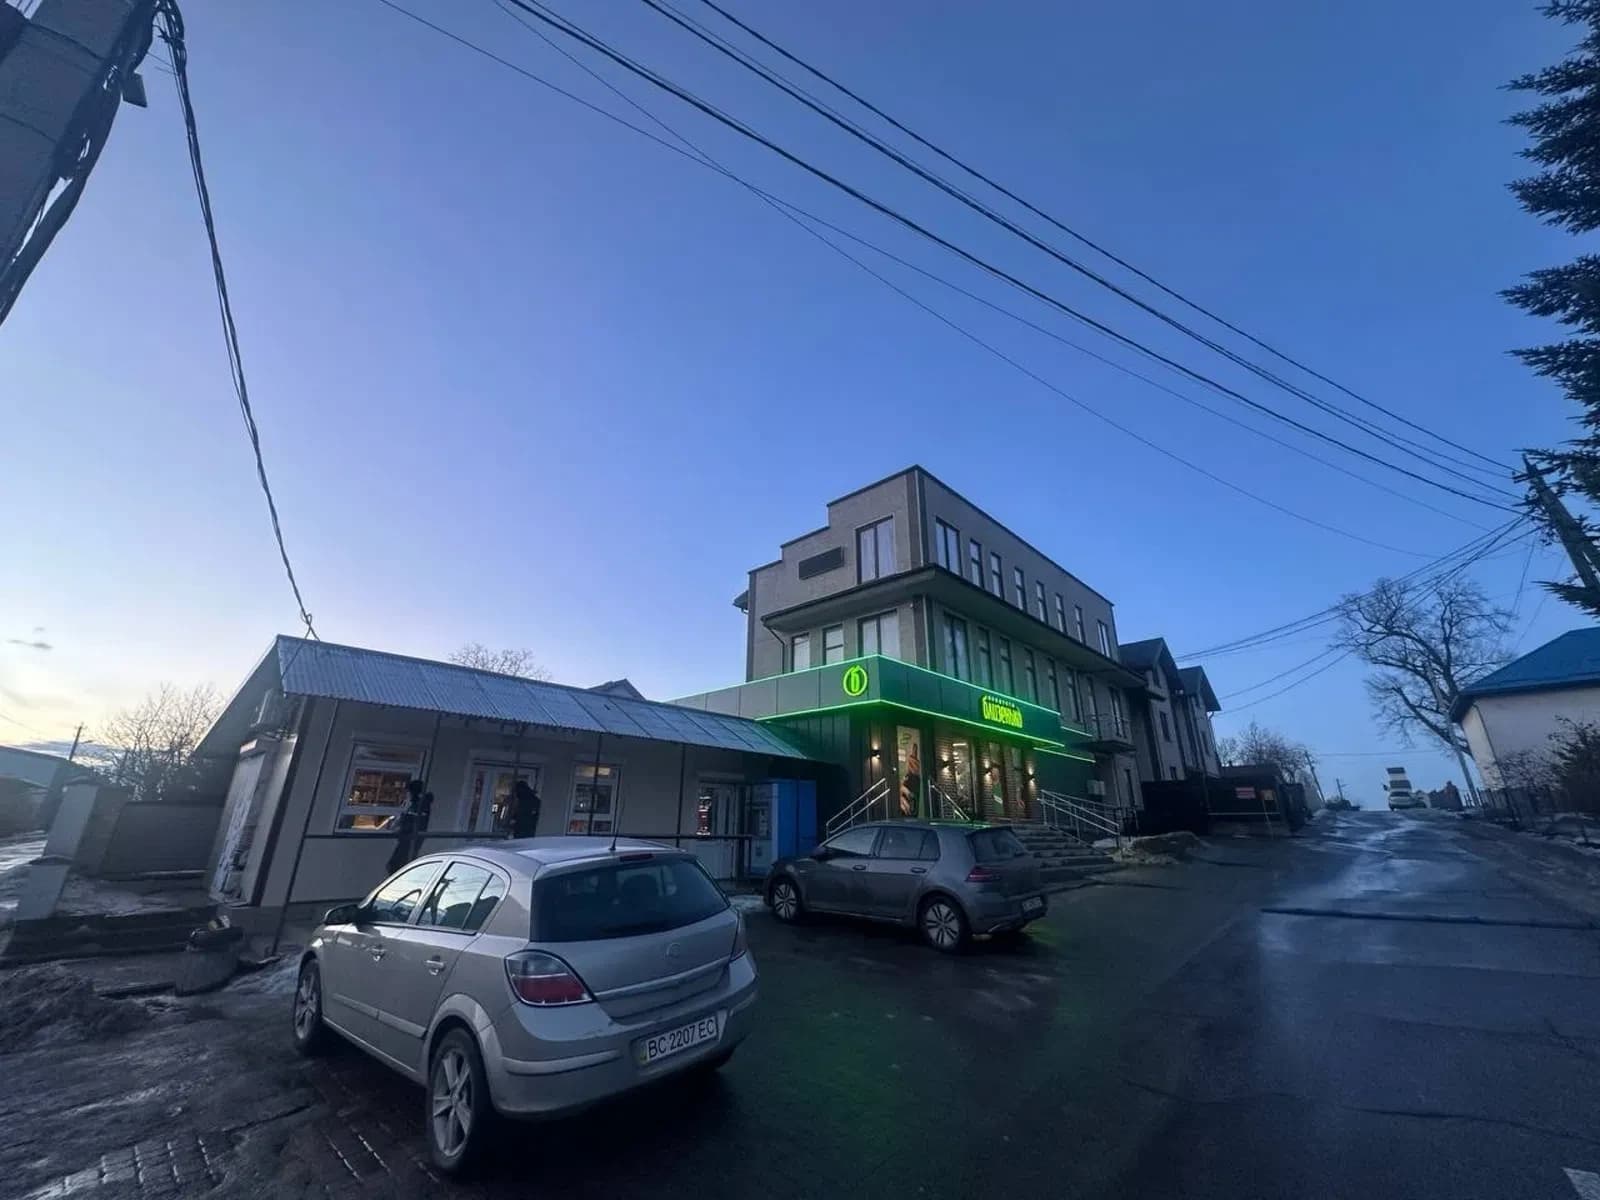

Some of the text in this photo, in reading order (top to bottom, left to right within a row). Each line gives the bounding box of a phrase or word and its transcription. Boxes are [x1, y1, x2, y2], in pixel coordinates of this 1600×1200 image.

[648, 1019, 715, 1058] BC 2207 EC
